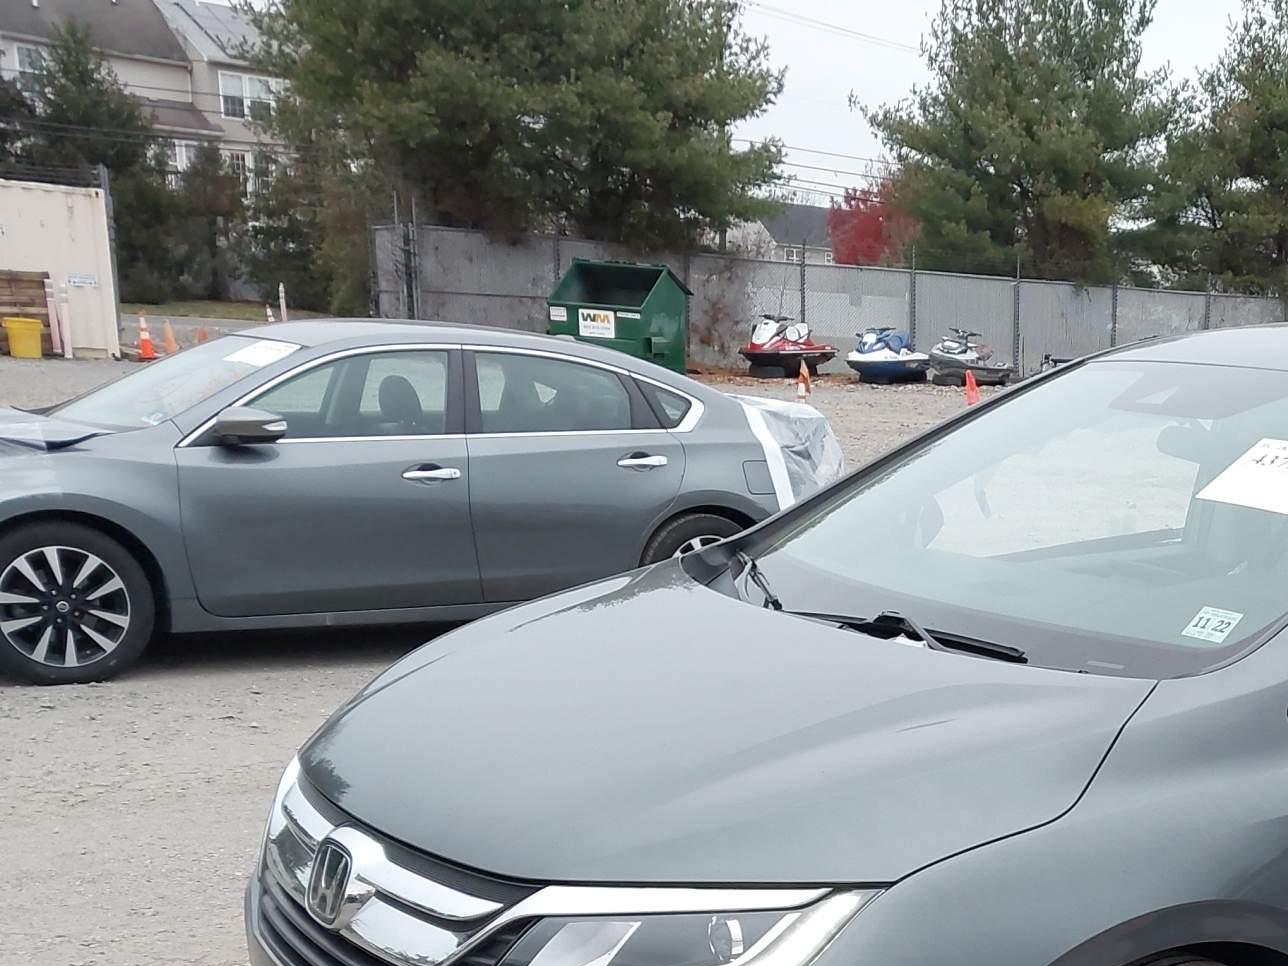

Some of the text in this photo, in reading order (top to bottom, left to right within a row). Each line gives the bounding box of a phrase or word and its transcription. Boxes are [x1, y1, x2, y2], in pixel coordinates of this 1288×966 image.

[581, 312, 610, 324] WM
[1192, 616, 1231, 633] 11 22
